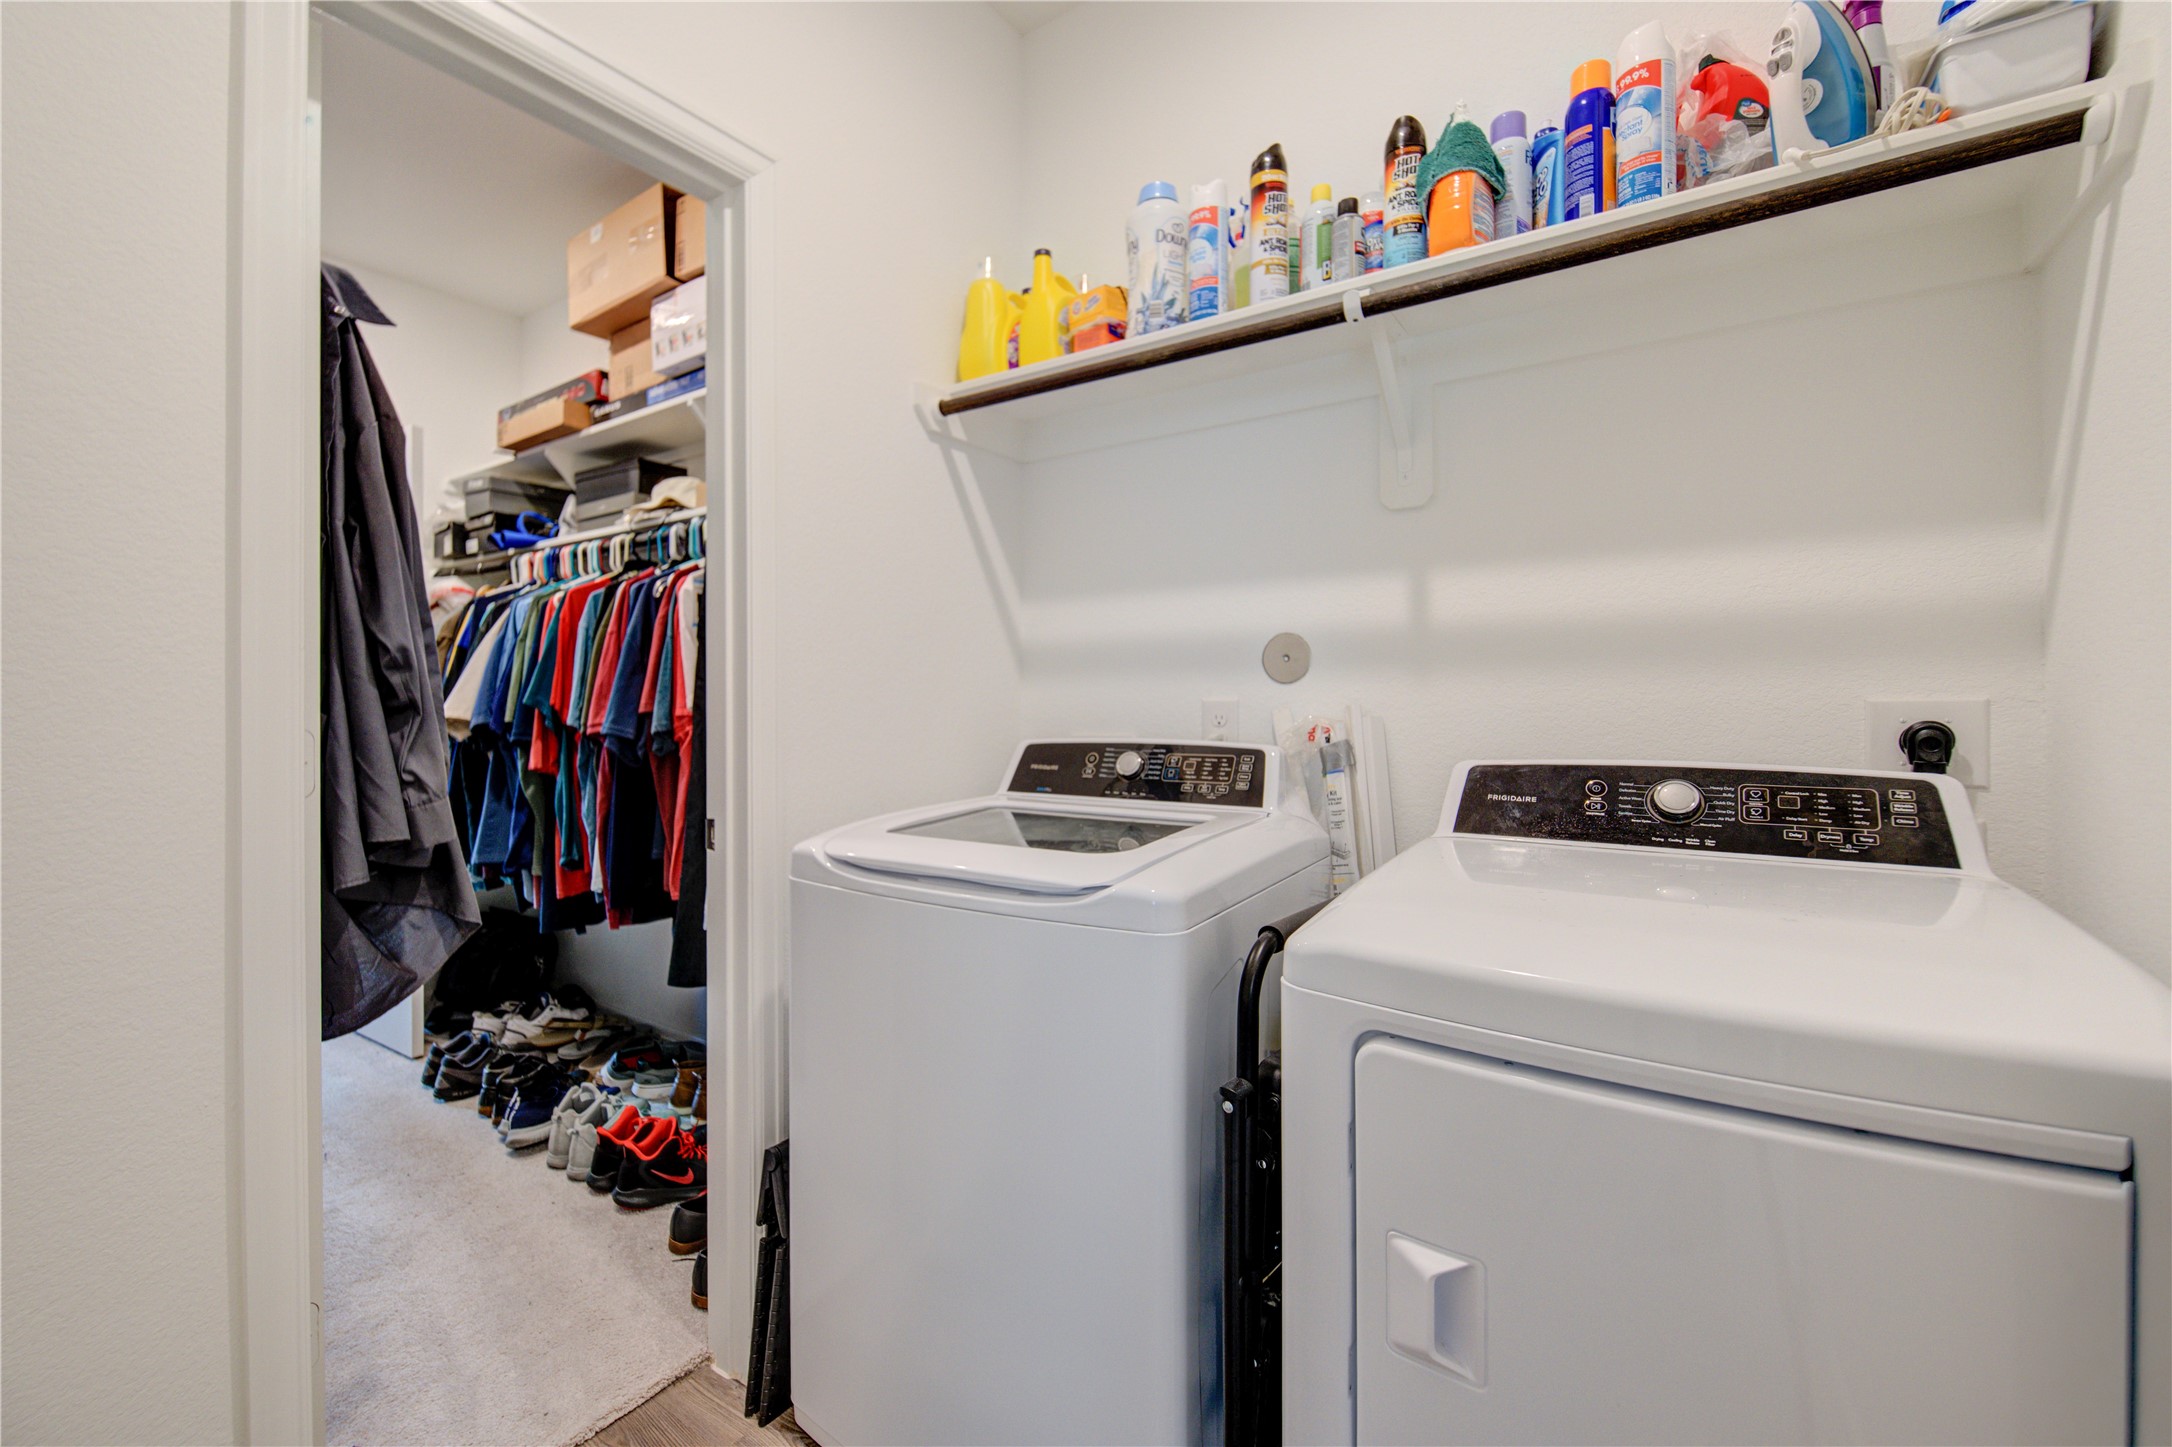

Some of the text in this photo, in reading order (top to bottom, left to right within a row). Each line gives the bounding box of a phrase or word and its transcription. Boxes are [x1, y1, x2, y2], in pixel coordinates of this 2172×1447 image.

[1620, 67, 1650, 88] 99.9%
[1397, 155, 1419, 170] HOT
[1393, 165, 1417, 181] SHO
[1267, 192, 1288, 204] HOT
[1388, 193, 1402, 204] ANT
[1397, 198, 1420, 207] SPIDE
[1264, 203, 1288, 215] SHO
[1156, 228, 1189, 250] Down
[1269, 244, 1289, 255] SPIDE
[1487, 793, 1537, 803] FRIGIDAIRE
